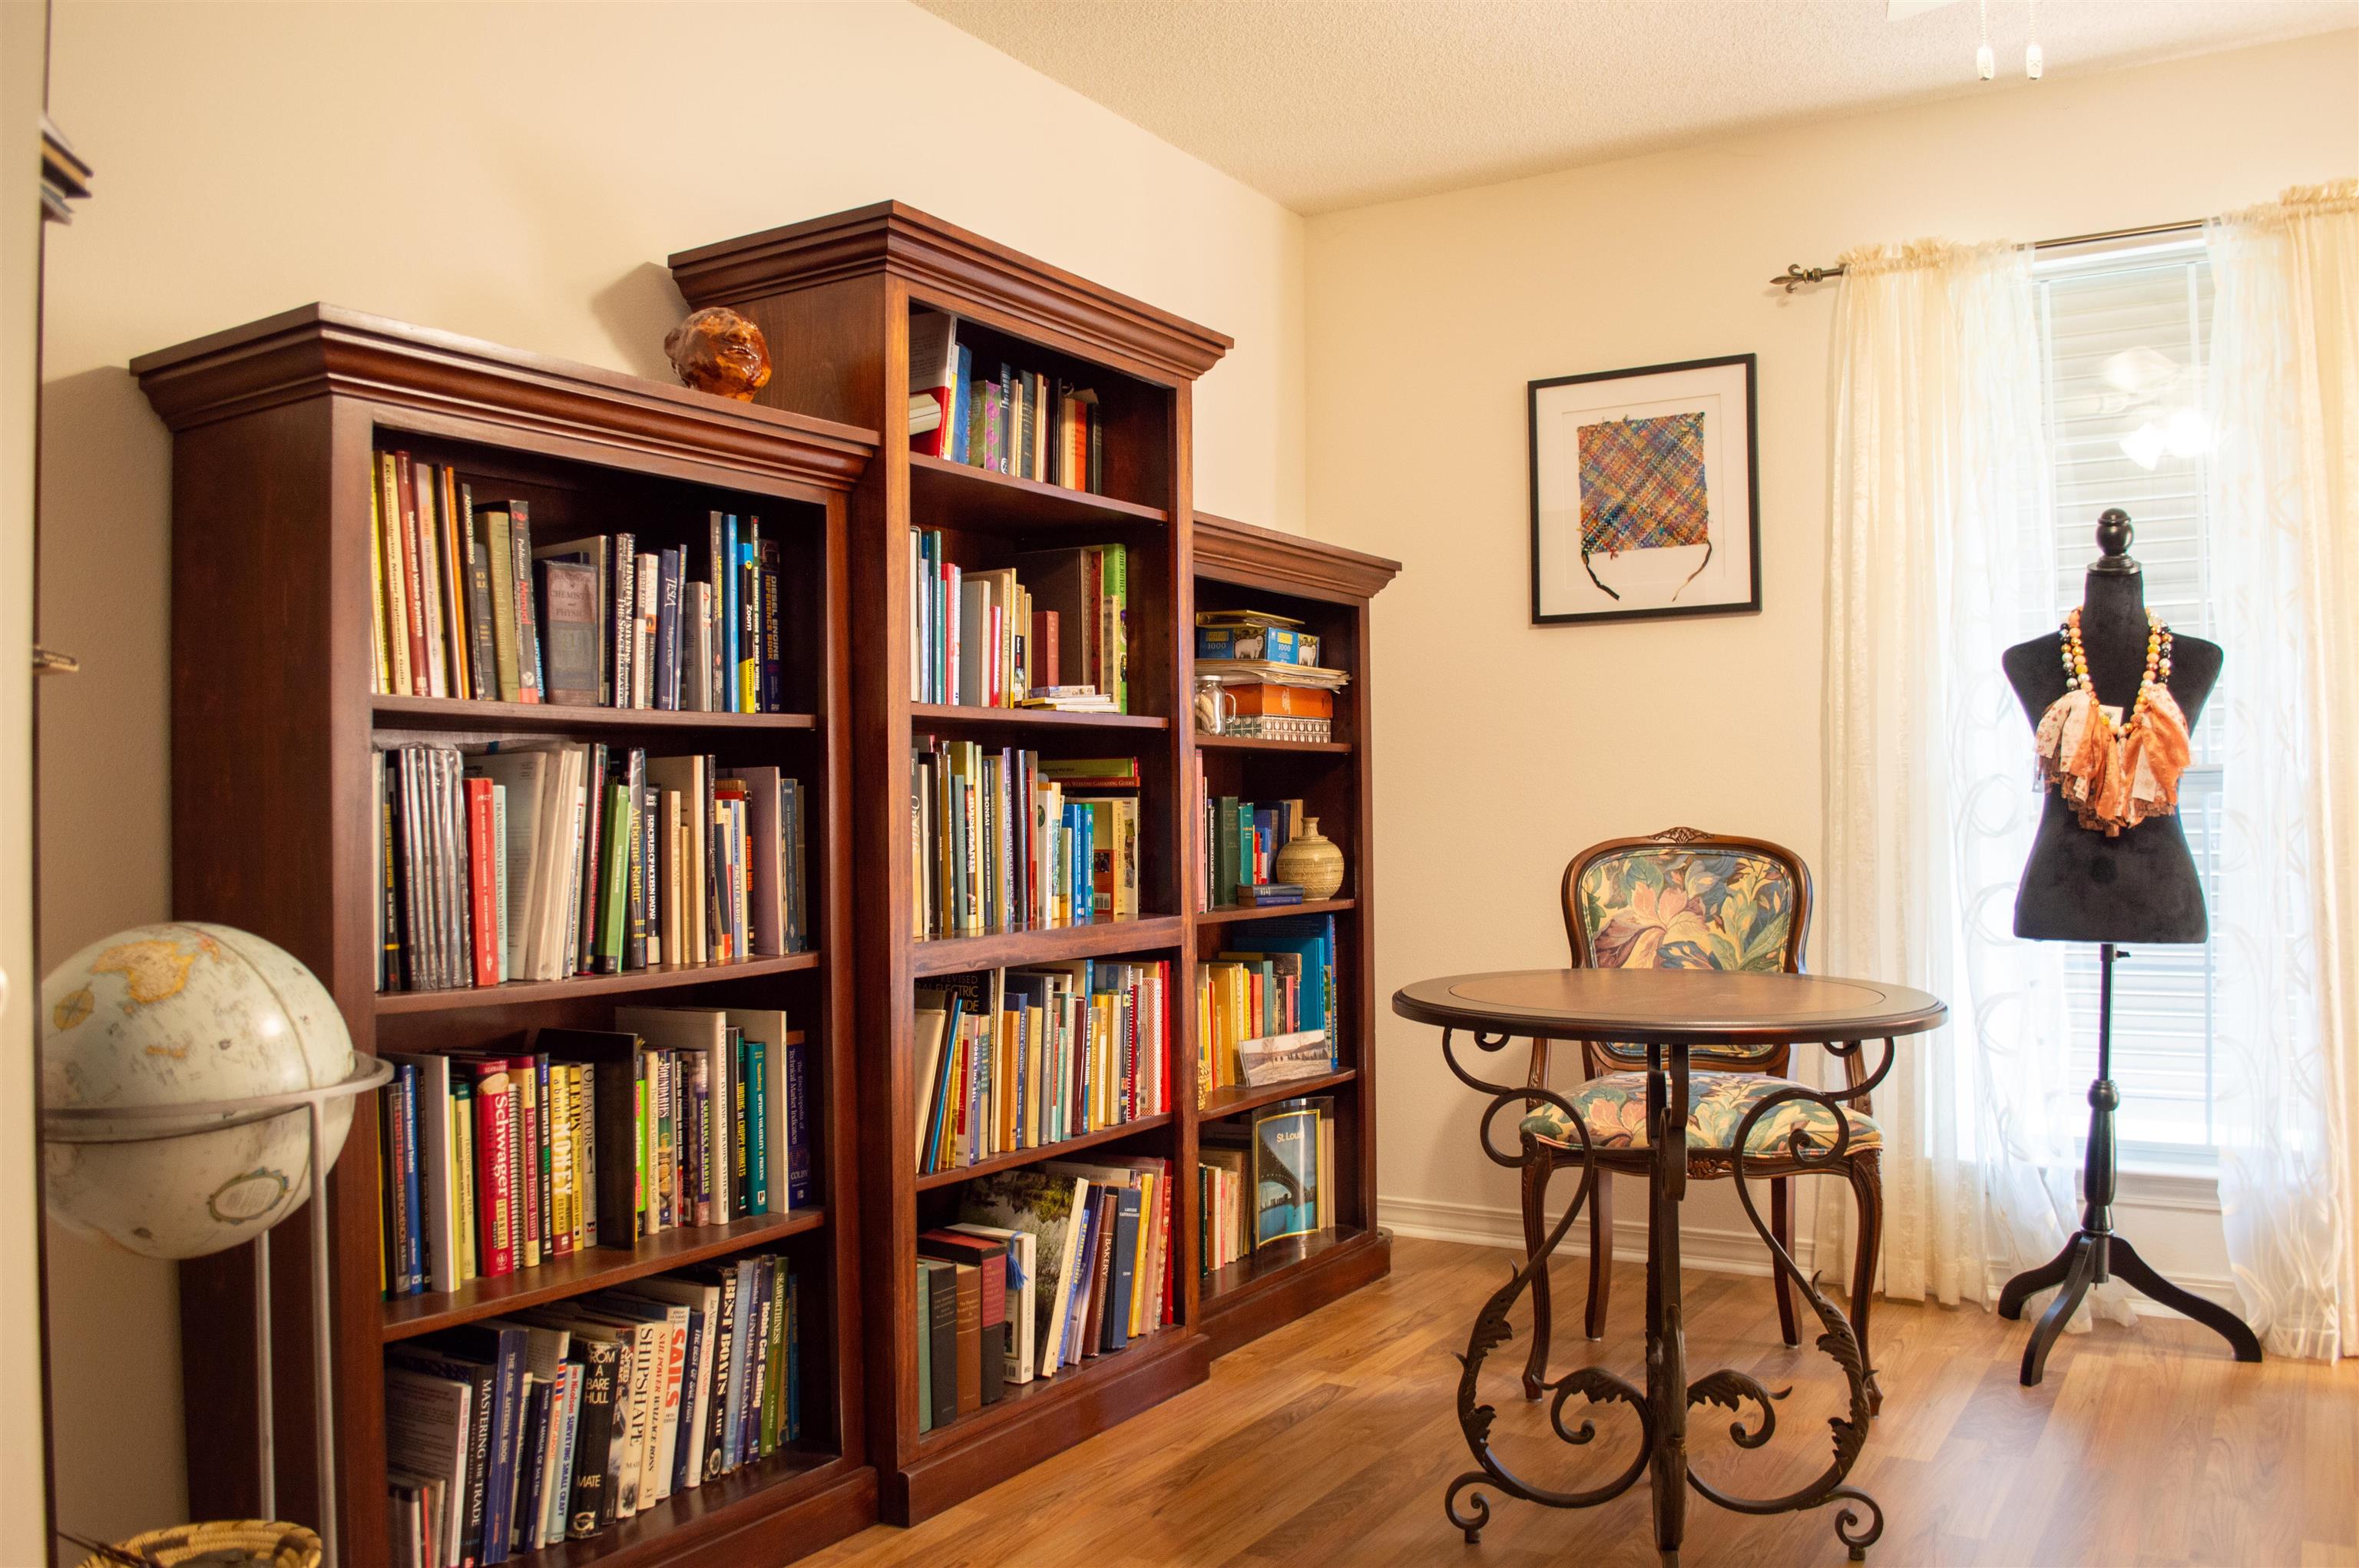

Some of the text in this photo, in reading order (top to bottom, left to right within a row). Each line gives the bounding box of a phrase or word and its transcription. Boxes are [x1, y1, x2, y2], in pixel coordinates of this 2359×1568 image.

[408, 511, 419, 553] Television
[465, 495, 474, 535] ADVANCED
[517, 538, 526, 579] Publication
[412, 574, 421, 599] Video
[520, 581, 531, 624] Manual
[664, 577, 677, 607] TESLA
[414, 600, 423, 637] Systems
[493, 551, 508, 662] Algebra and Trigonometry
[617, 620, 626, 651] SPACE
[632, 808, 642, 903] Airborne Radar
[648, 853, 654, 864] OF
[405, 1073, 413, 1120] Ultra-Reliable
[553, 1079, 562, 1120] about
[658, 1062, 670, 1118] BOUNDARIES
[737, 1082, 746, 1110] TRADING
[737, 1121, 746, 1144] CHOPPY
[799, 1119, 805, 1129] of
[492, 1096, 508, 1196] Schwager
[552, 1122, 572, 1195] MONEY
[497, 1199, 507, 1249] TECHNICAL
[557, 1198, 565, 1231] EDELMAN
[1102, 1239, 1112, 1277] BAKERY
[752, 1269, 761, 1305] Rosenfeld
[773, 1272, 785, 1344] SEAWORTHINESS
[717, 1279, 736, 1396] BEST BOATS
[746, 1312, 758, 1359] UNDER
[753, 1302, 771, 1408] Hobie Cat Sailing
[586, 1378, 610, 1390] BARE
[595, 1365, 603, 1376] A
[630, 1328, 653, 1447] SHIPSHAPE
[665, 1328, 686, 1408] SAILS
[690, 1368, 697, 1380] OF
[743, 1362, 755, 1393] FULL
[500, 1352, 515, 1463] THE ARRL ANTENNA BOOK
[568, 1381, 577, 1414] Nicolson
[584, 1390, 608, 1404] HULL
[648, 1332, 666, 1472] SAIL POWER WALLACE ROSS
[688, 1382, 696, 1401] SAIL
[740, 1394, 752, 1424] SAIL
[477, 1379, 492, 1460] MASTERING
[685, 1401, 693, 1424] TRIM
[563, 1415, 574, 1460] SURVEYING
[561, 1463, 570, 1490] SMALL
[577, 1474, 601, 1487] MATE
[471, 1483, 484, 1527] TRADE
[557, 1492, 567, 1517] CRAFT
